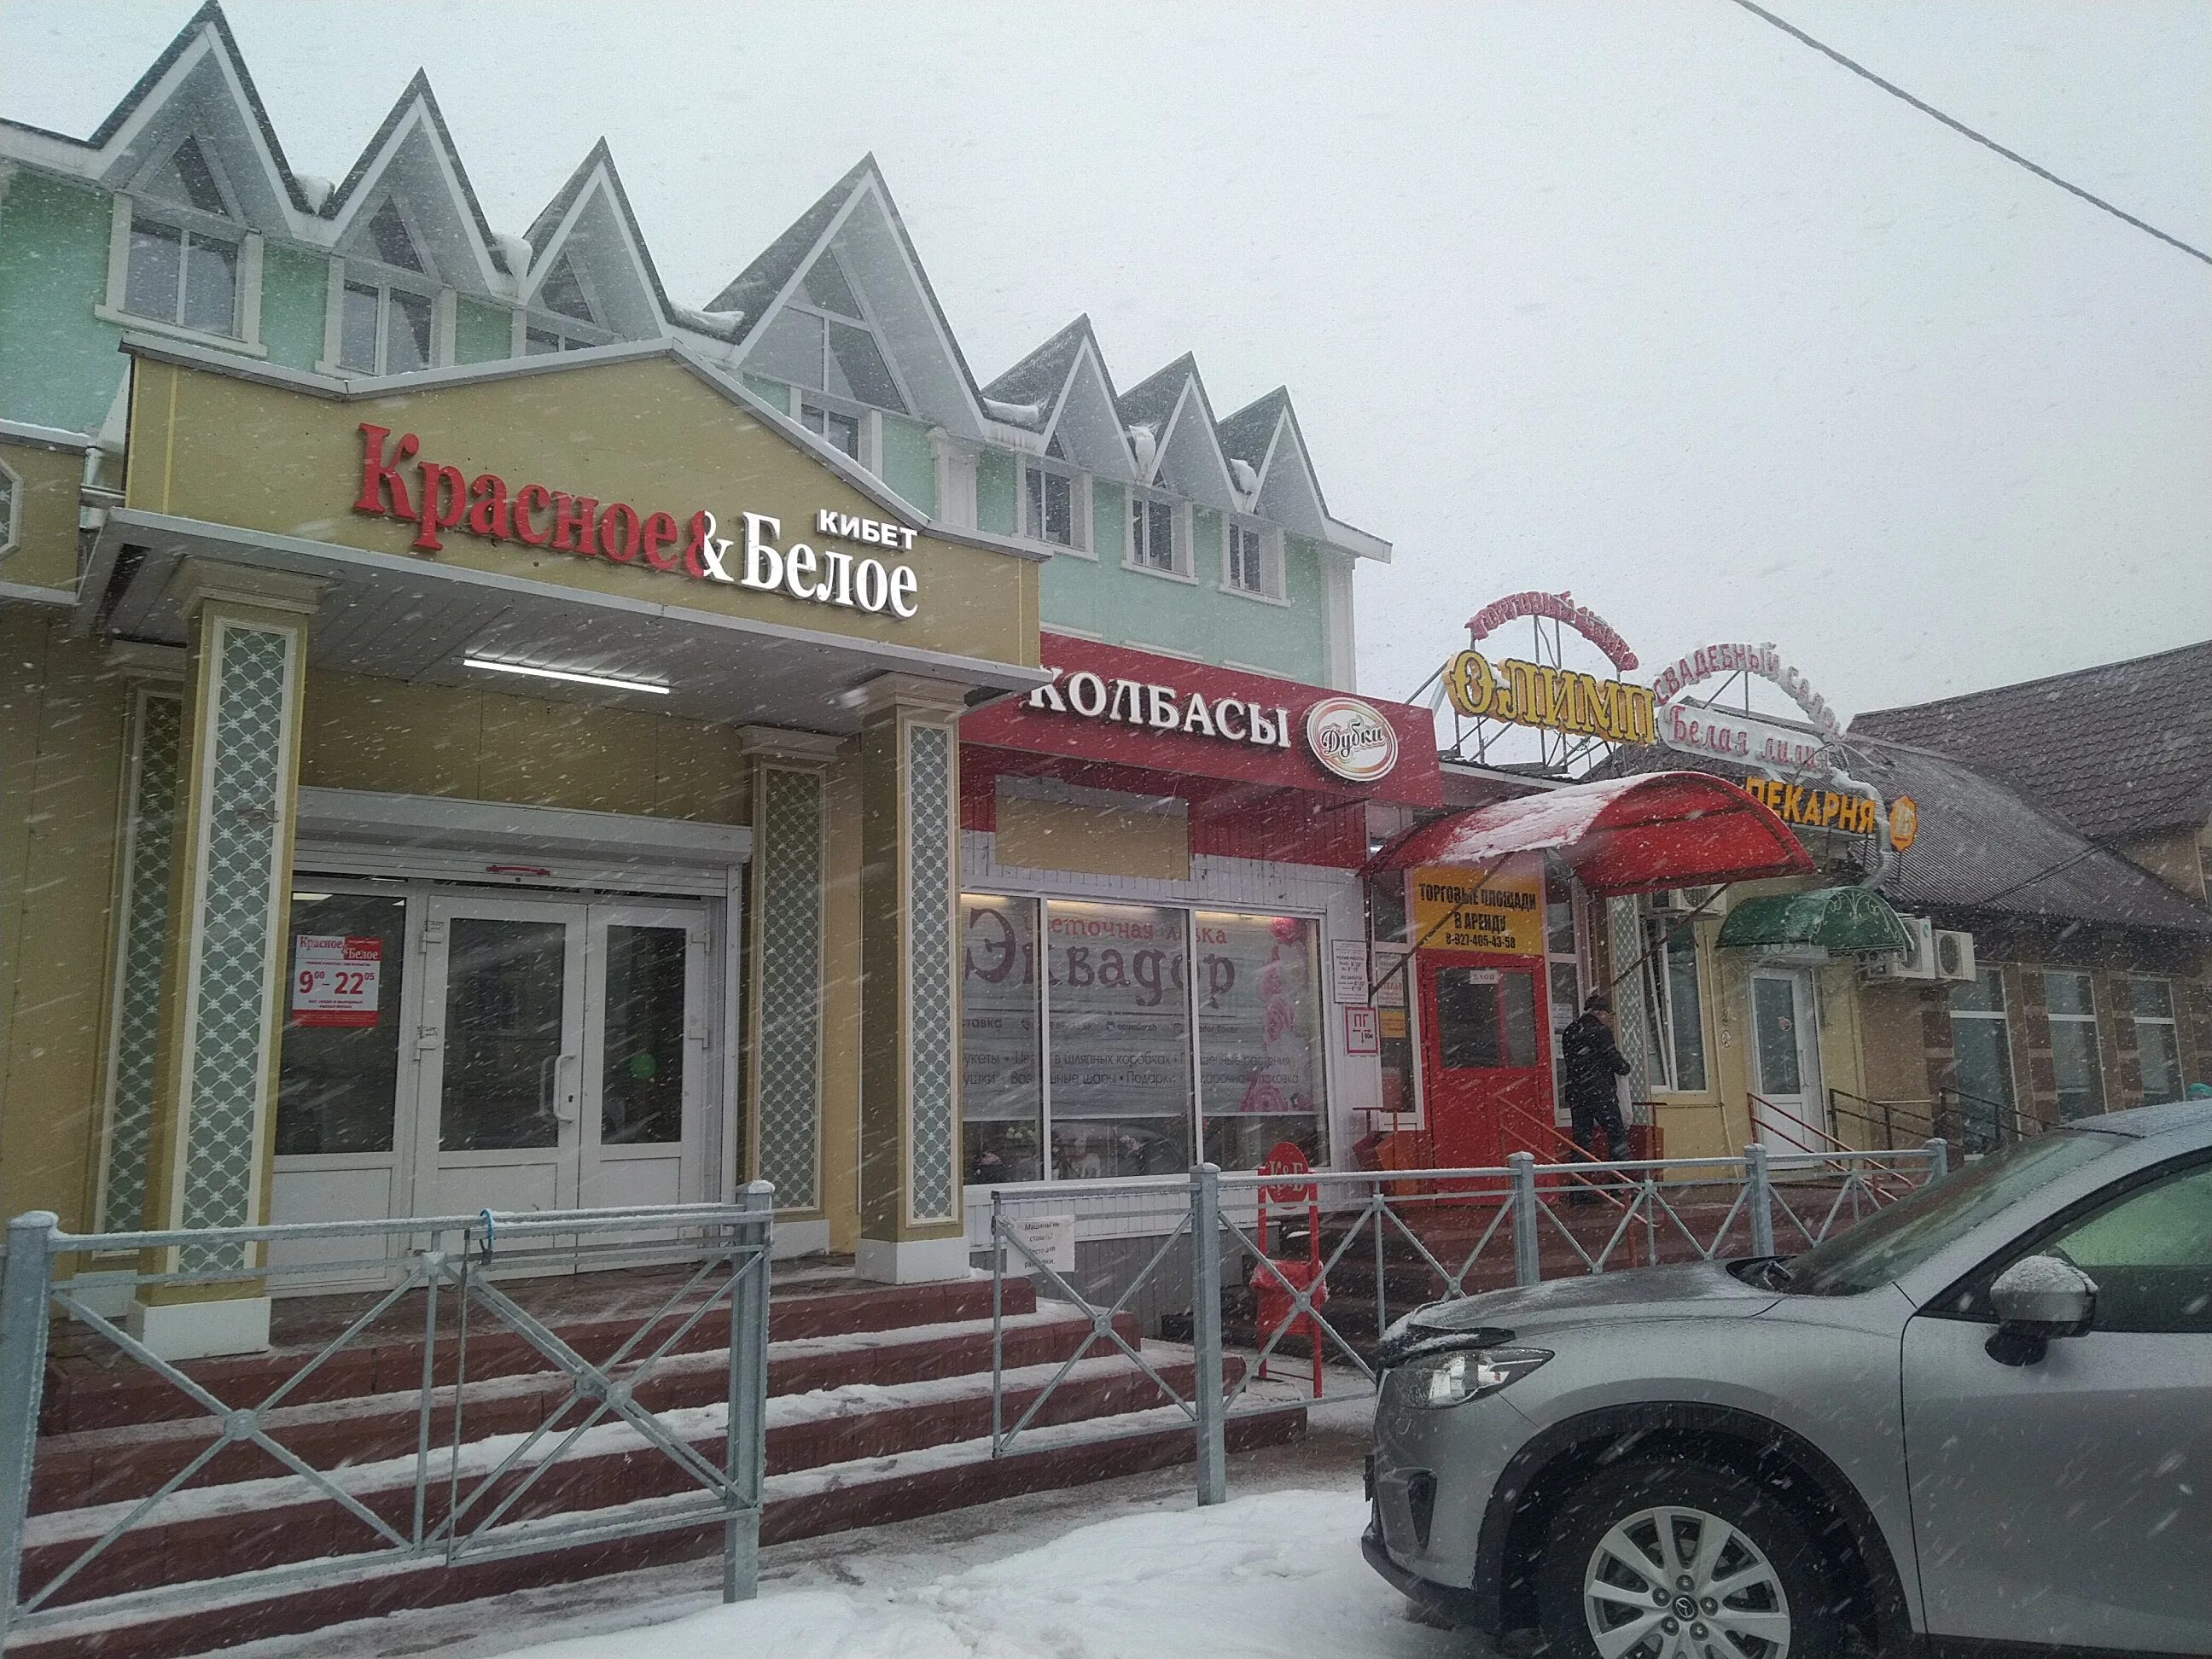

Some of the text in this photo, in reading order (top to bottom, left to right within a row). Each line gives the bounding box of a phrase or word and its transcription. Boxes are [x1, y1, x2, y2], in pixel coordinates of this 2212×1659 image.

[817, 509, 918, 551] КИБЕТ
[1653, 642, 1782, 707] СВАДЕБНЫЙ
[1446, 649, 1658, 746] ОЛИМП
[1320, 720, 1386, 760] Дубки
[1669, 705, 1749, 757] Белая
[1746, 775, 1877, 834] ПЕКАРНЯ
[1481, 888, 1536, 911] ПЛОЩАДИ
[1454, 912, 1507, 934] В АРЕНДУ
[962, 1051, 998, 1068] укеты
